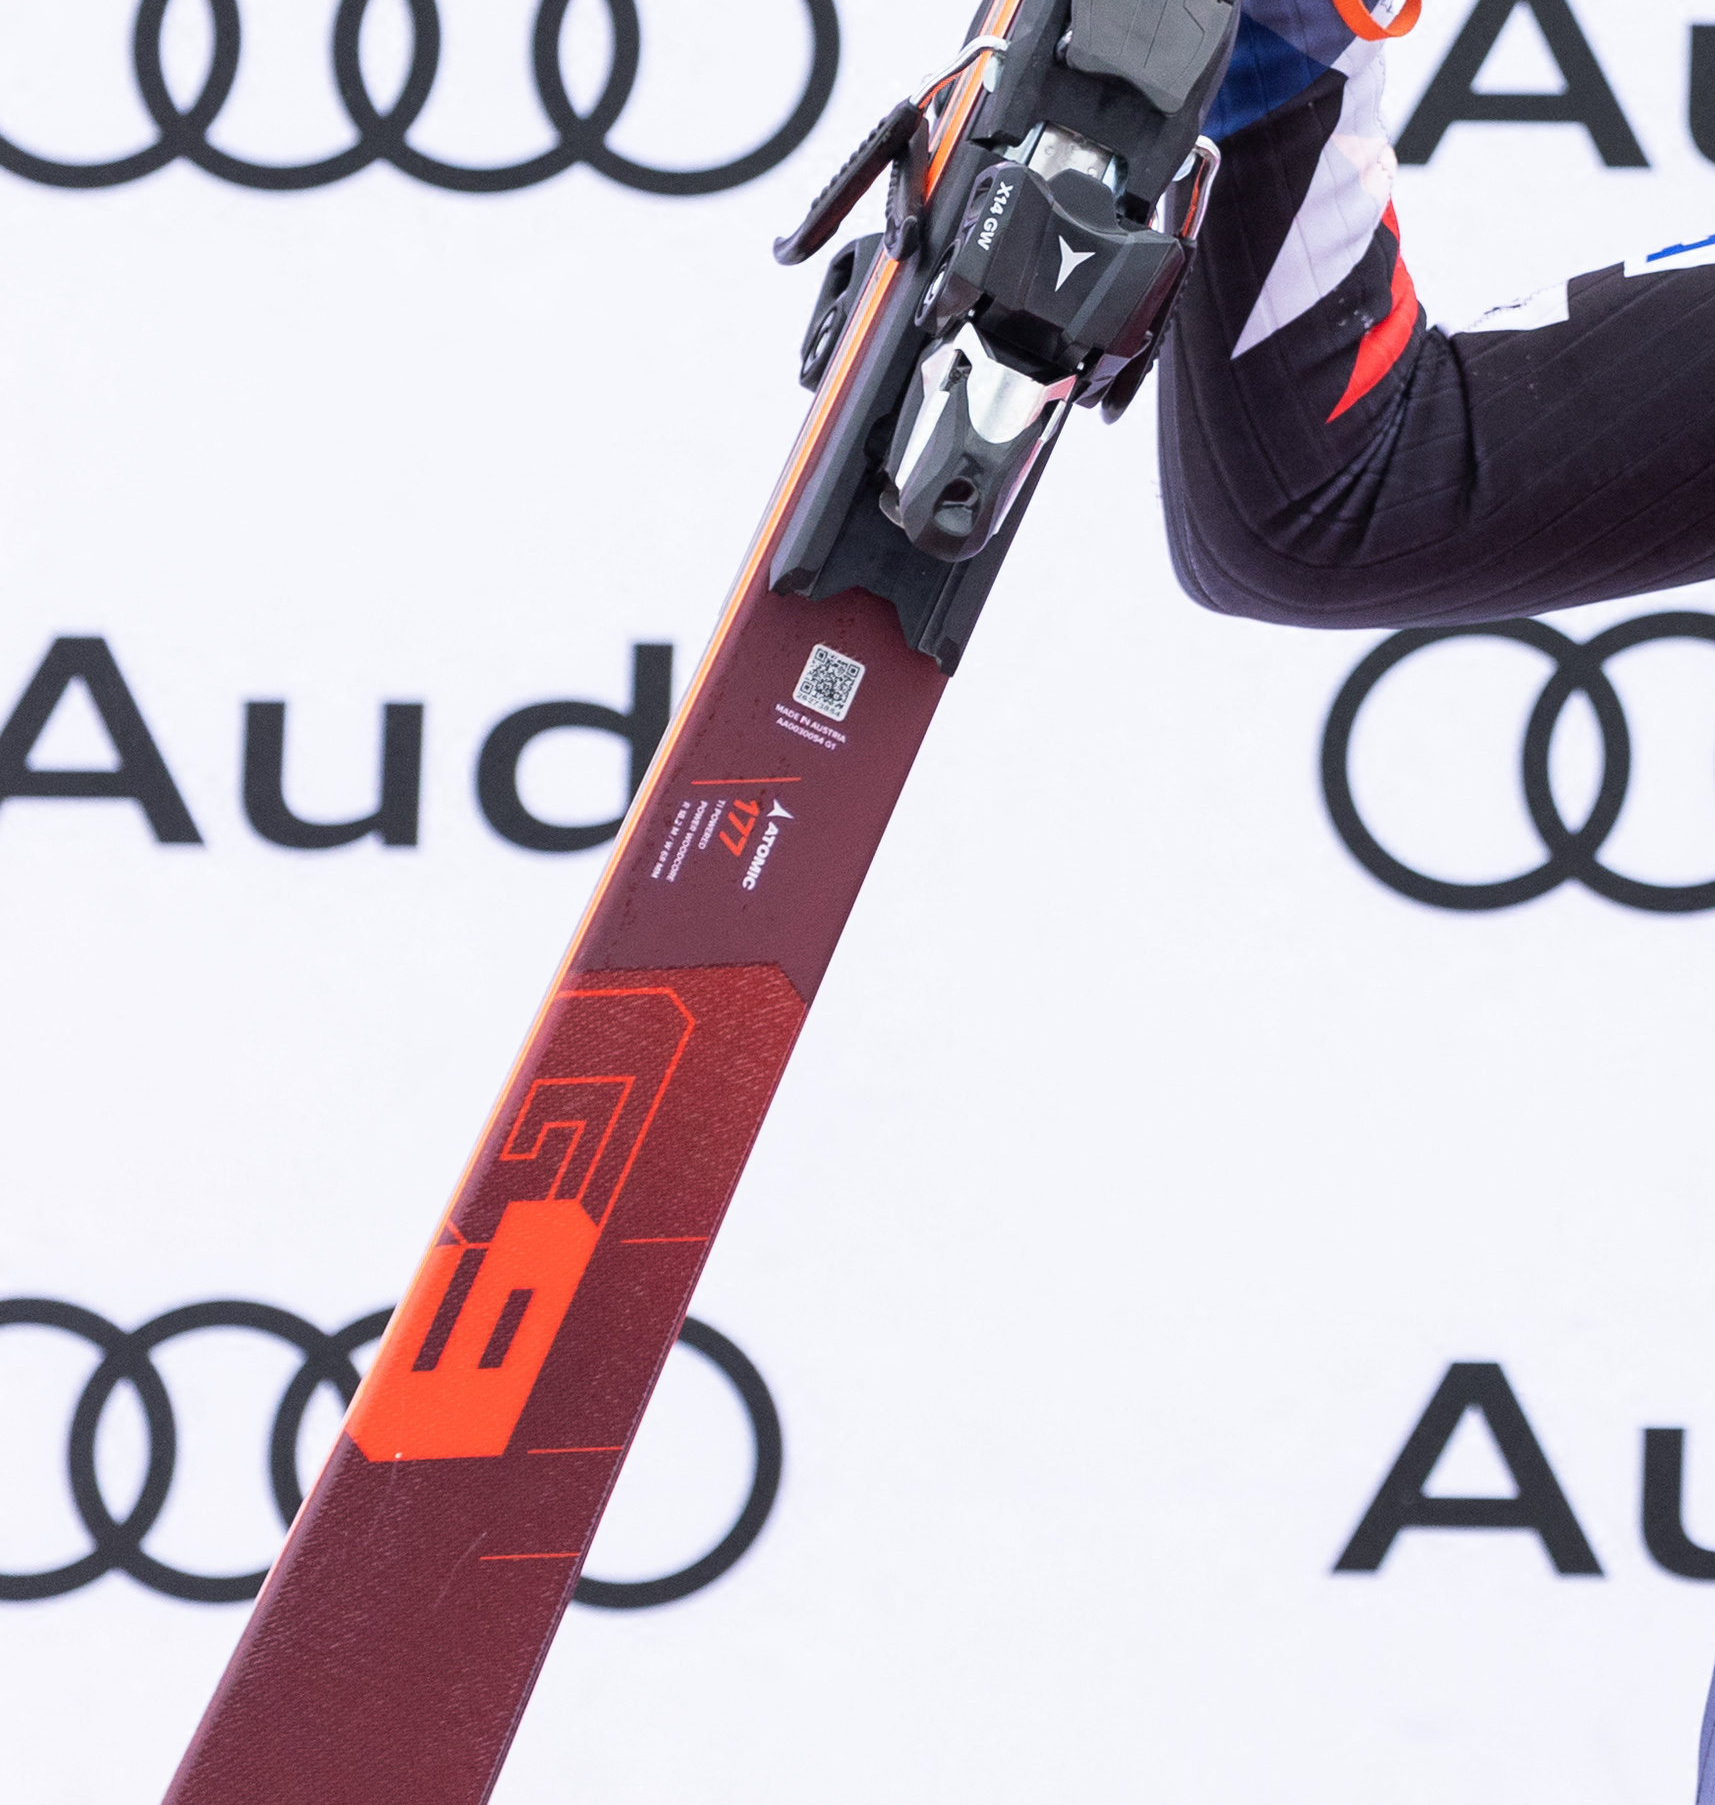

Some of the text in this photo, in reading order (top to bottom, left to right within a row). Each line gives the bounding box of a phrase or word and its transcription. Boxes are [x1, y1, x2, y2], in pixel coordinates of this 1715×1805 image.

[977, 181, 1014, 251] X14 GW
[0, 636, 674, 852] Aud
[775, 703, 847, 744] MADE IN AUSTRIA
[665, 800, 709, 883] POWER WOODCORE
[698, 807, 722, 850] POWERED
[719, 799, 760, 857] 177
[742, 821, 779, 891] ATOMIC
